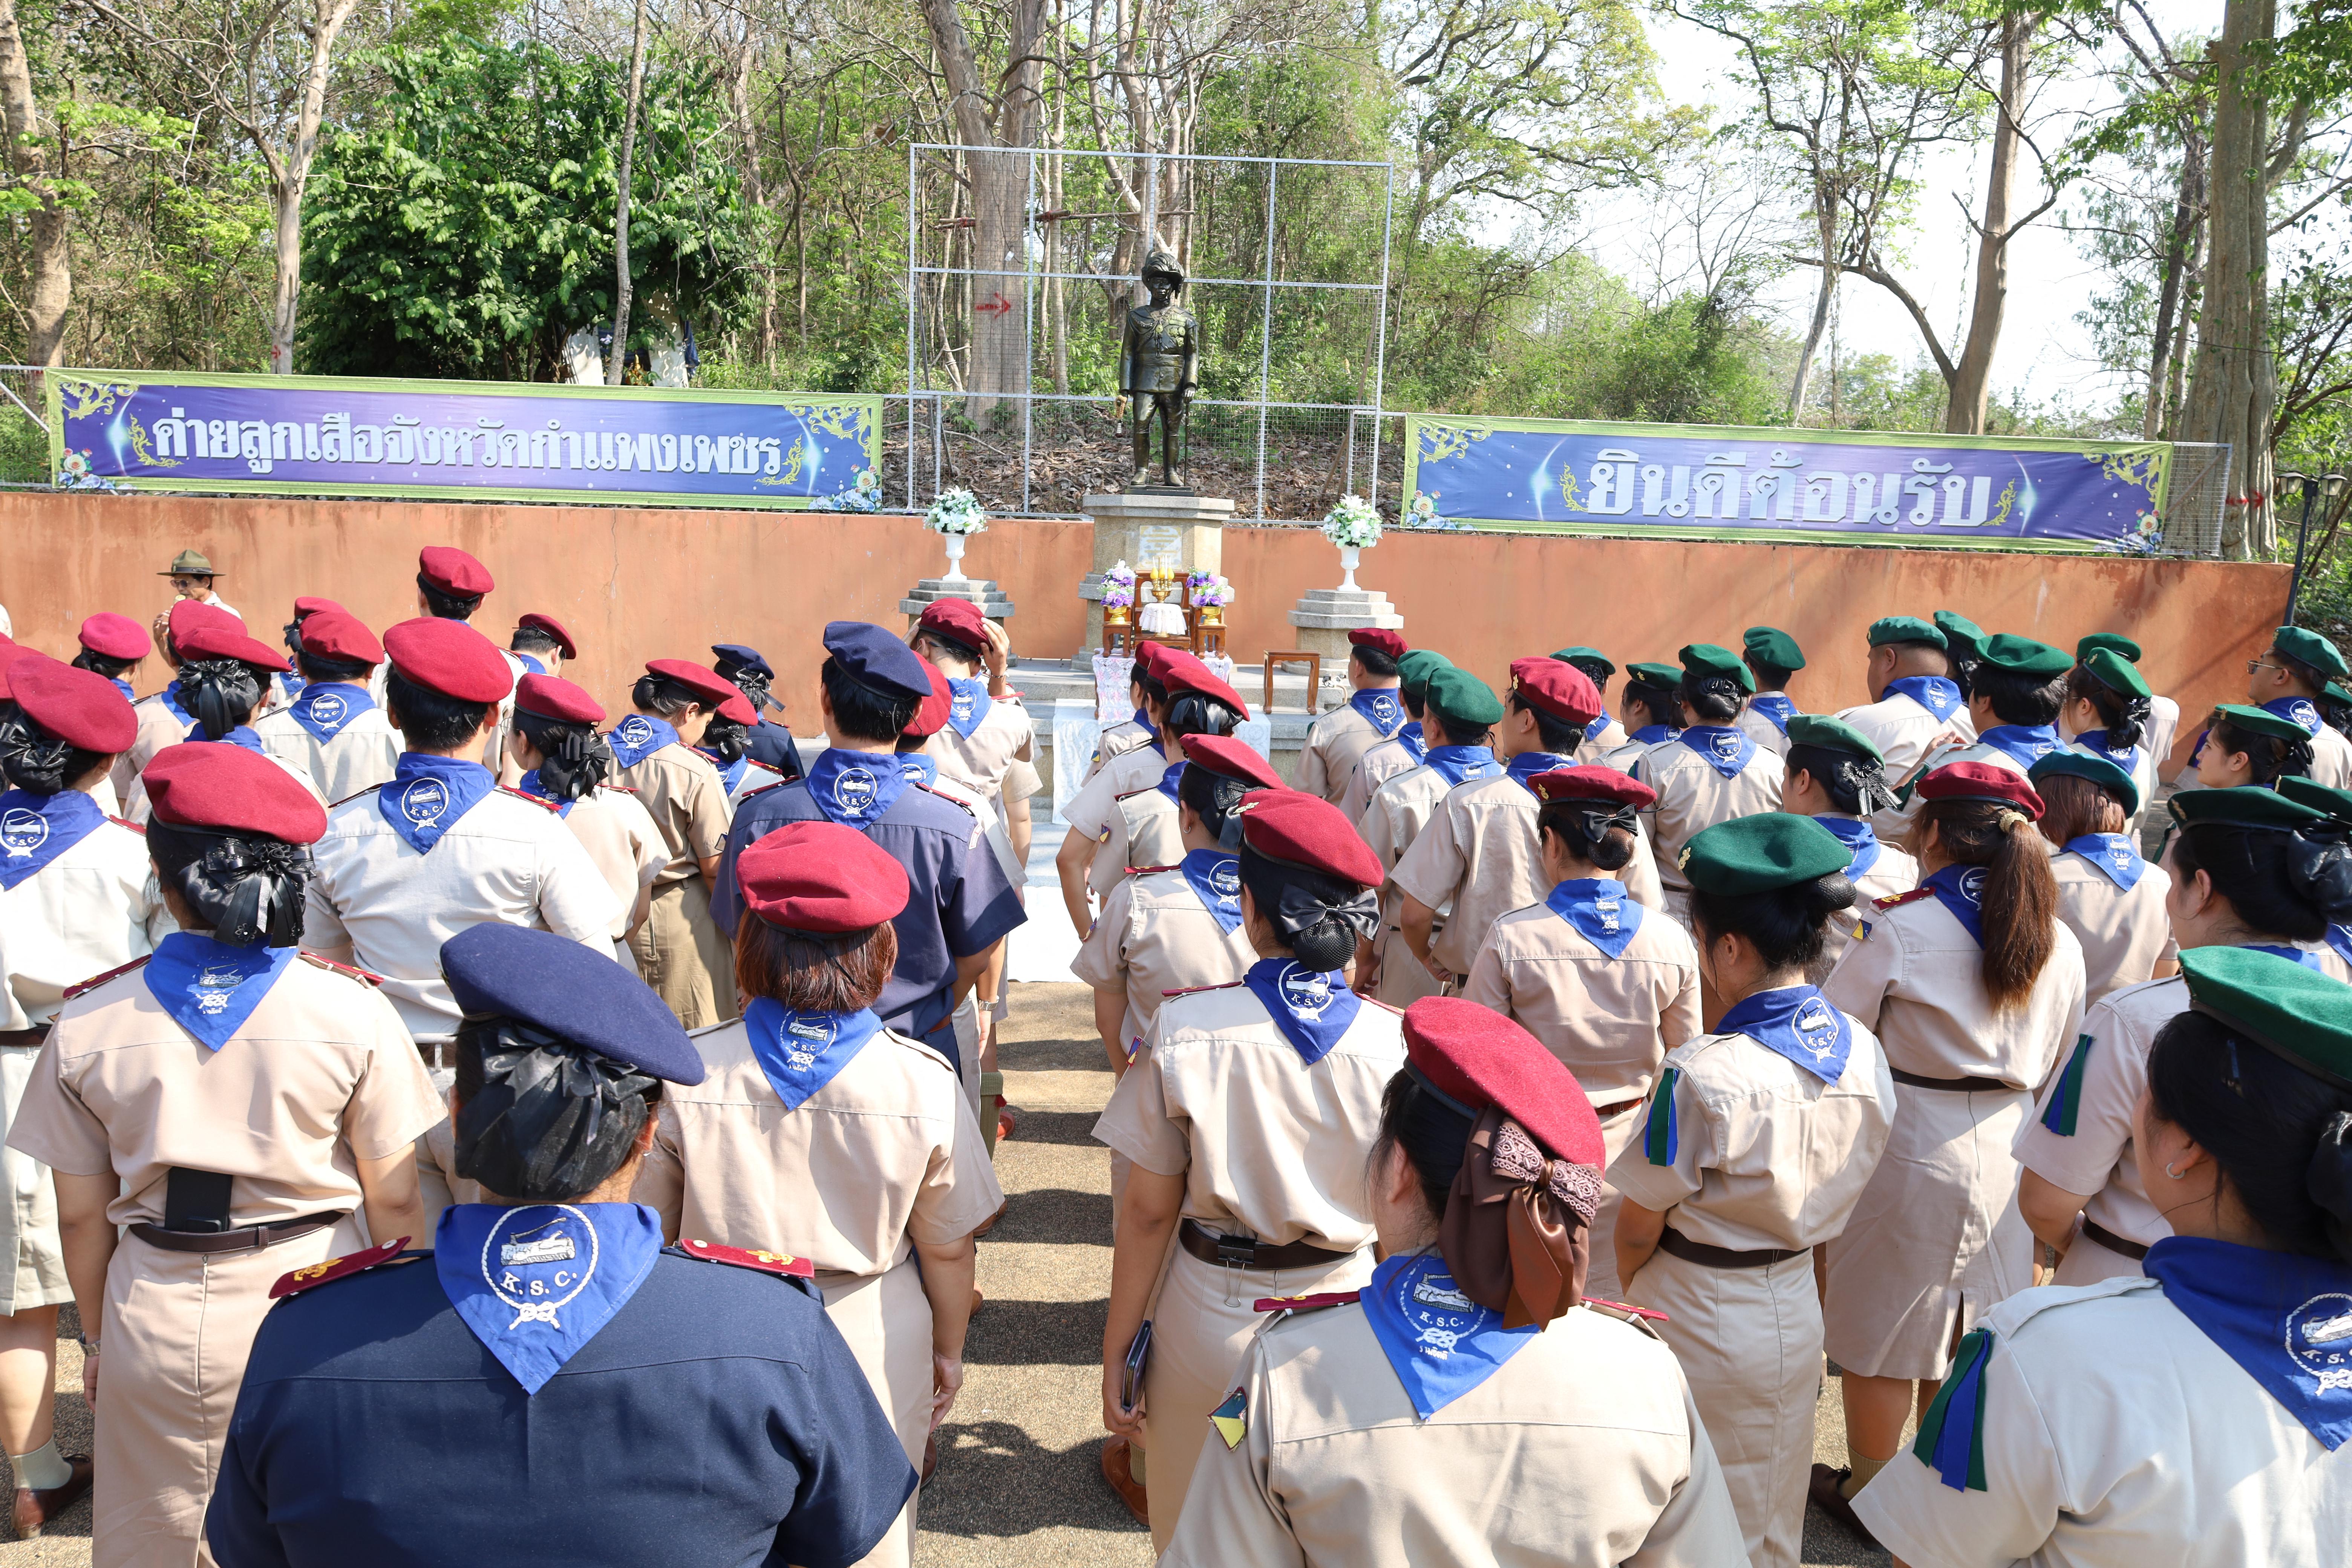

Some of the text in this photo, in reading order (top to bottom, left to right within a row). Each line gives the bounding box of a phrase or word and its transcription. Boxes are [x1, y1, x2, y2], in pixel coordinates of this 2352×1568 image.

[152, 407, 781, 475] ค่ายลูกเสือจังหวัดกำแพงเพชร
[1587, 448, 1992, 527] ยินดีต้อนรับ
[501, 1271, 577, 1296] K.S.C.
